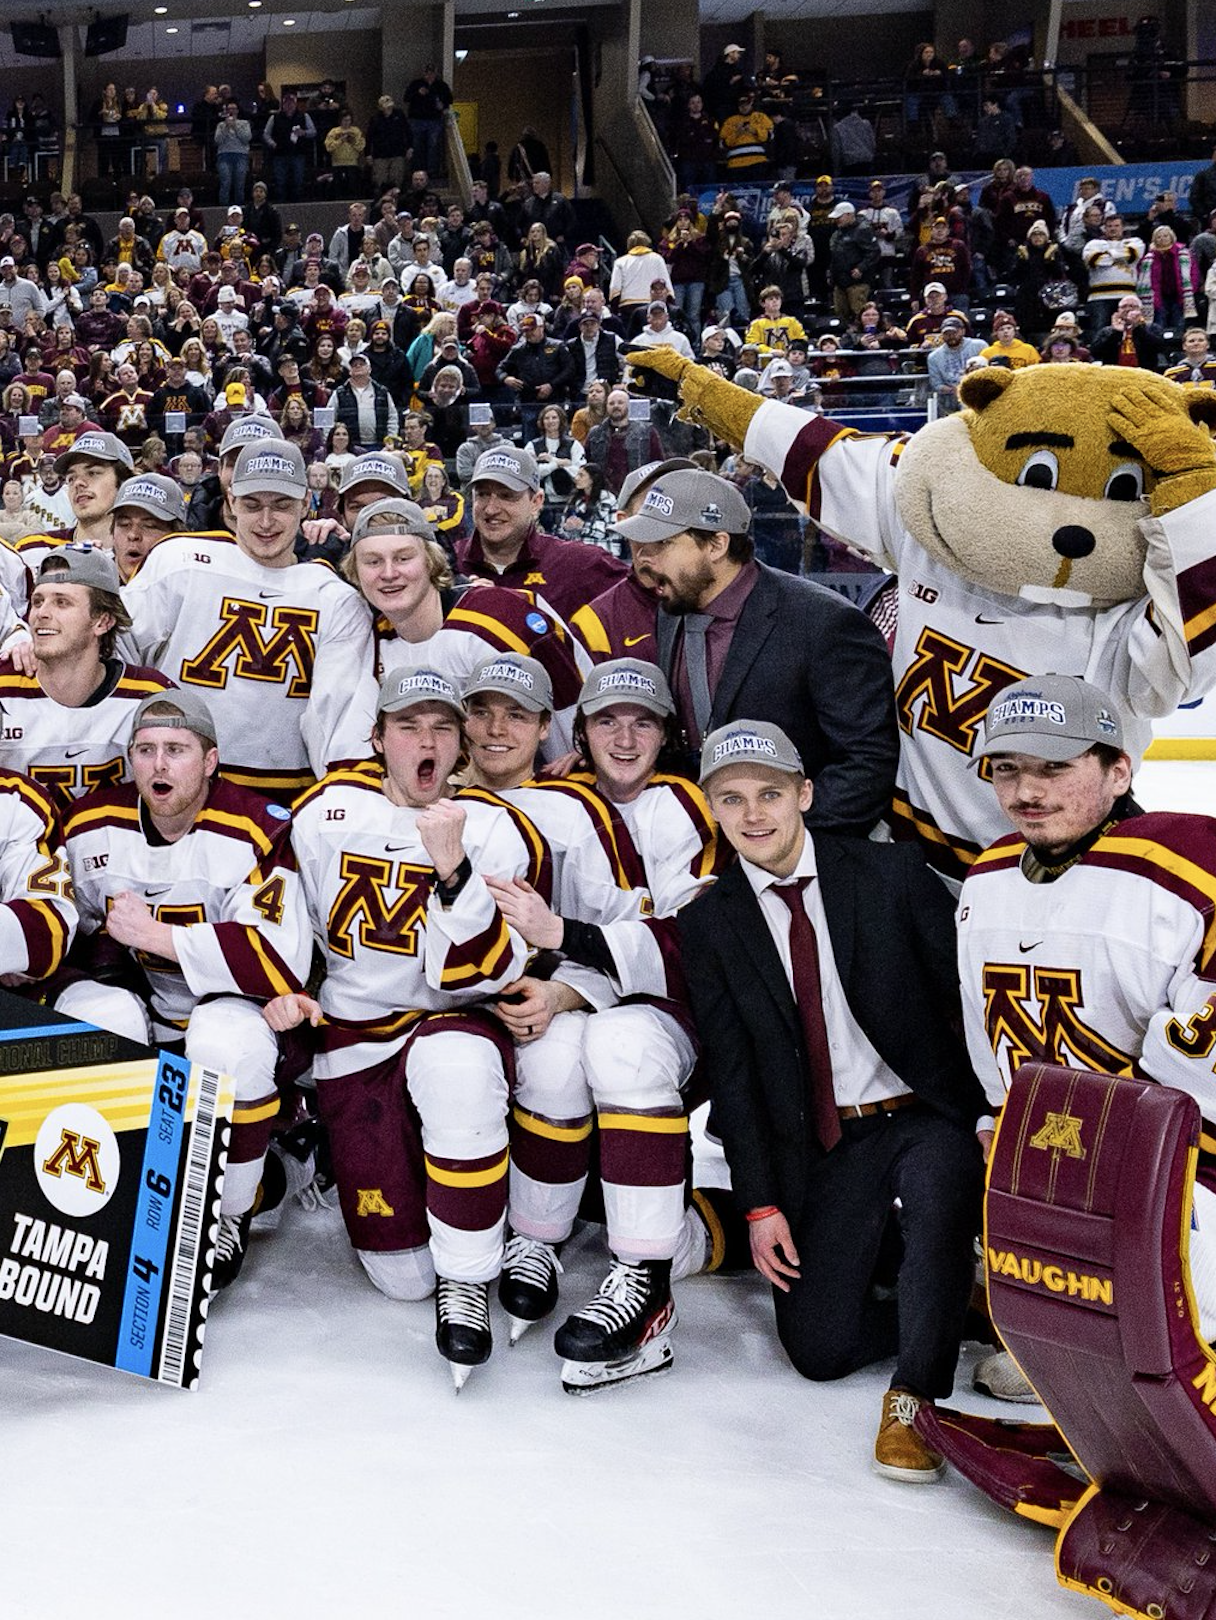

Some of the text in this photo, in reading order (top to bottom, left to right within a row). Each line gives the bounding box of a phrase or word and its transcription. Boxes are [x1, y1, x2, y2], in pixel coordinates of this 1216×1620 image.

[245, 455, 295, 477] CHAMPS
[122, 481, 168, 505] CHAMPS
[644, 490, 675, 517] MPS
[179, 596, 320, 699] M
[477, 665, 534, 691] CHAMPS
[596, 672, 657, 697] CHAMPS
[989, 698, 1067, 730] CHAMPS
[712, 735, 778, 765] CHAMPS
[252, 873, 286, 927] 4
[328, 850, 436, 961] M
[1029, 1110, 1088, 1161] M
[42, 1128, 107, 1195] M
[130, 1061, 187, 1350] SECTION 4 ROW 6 SEAT 23
[358, 1188, 395, 1218] M
[10, 1211, 110, 1281] TAMPA
[987, 1245, 1115, 1306] VAUGHN
